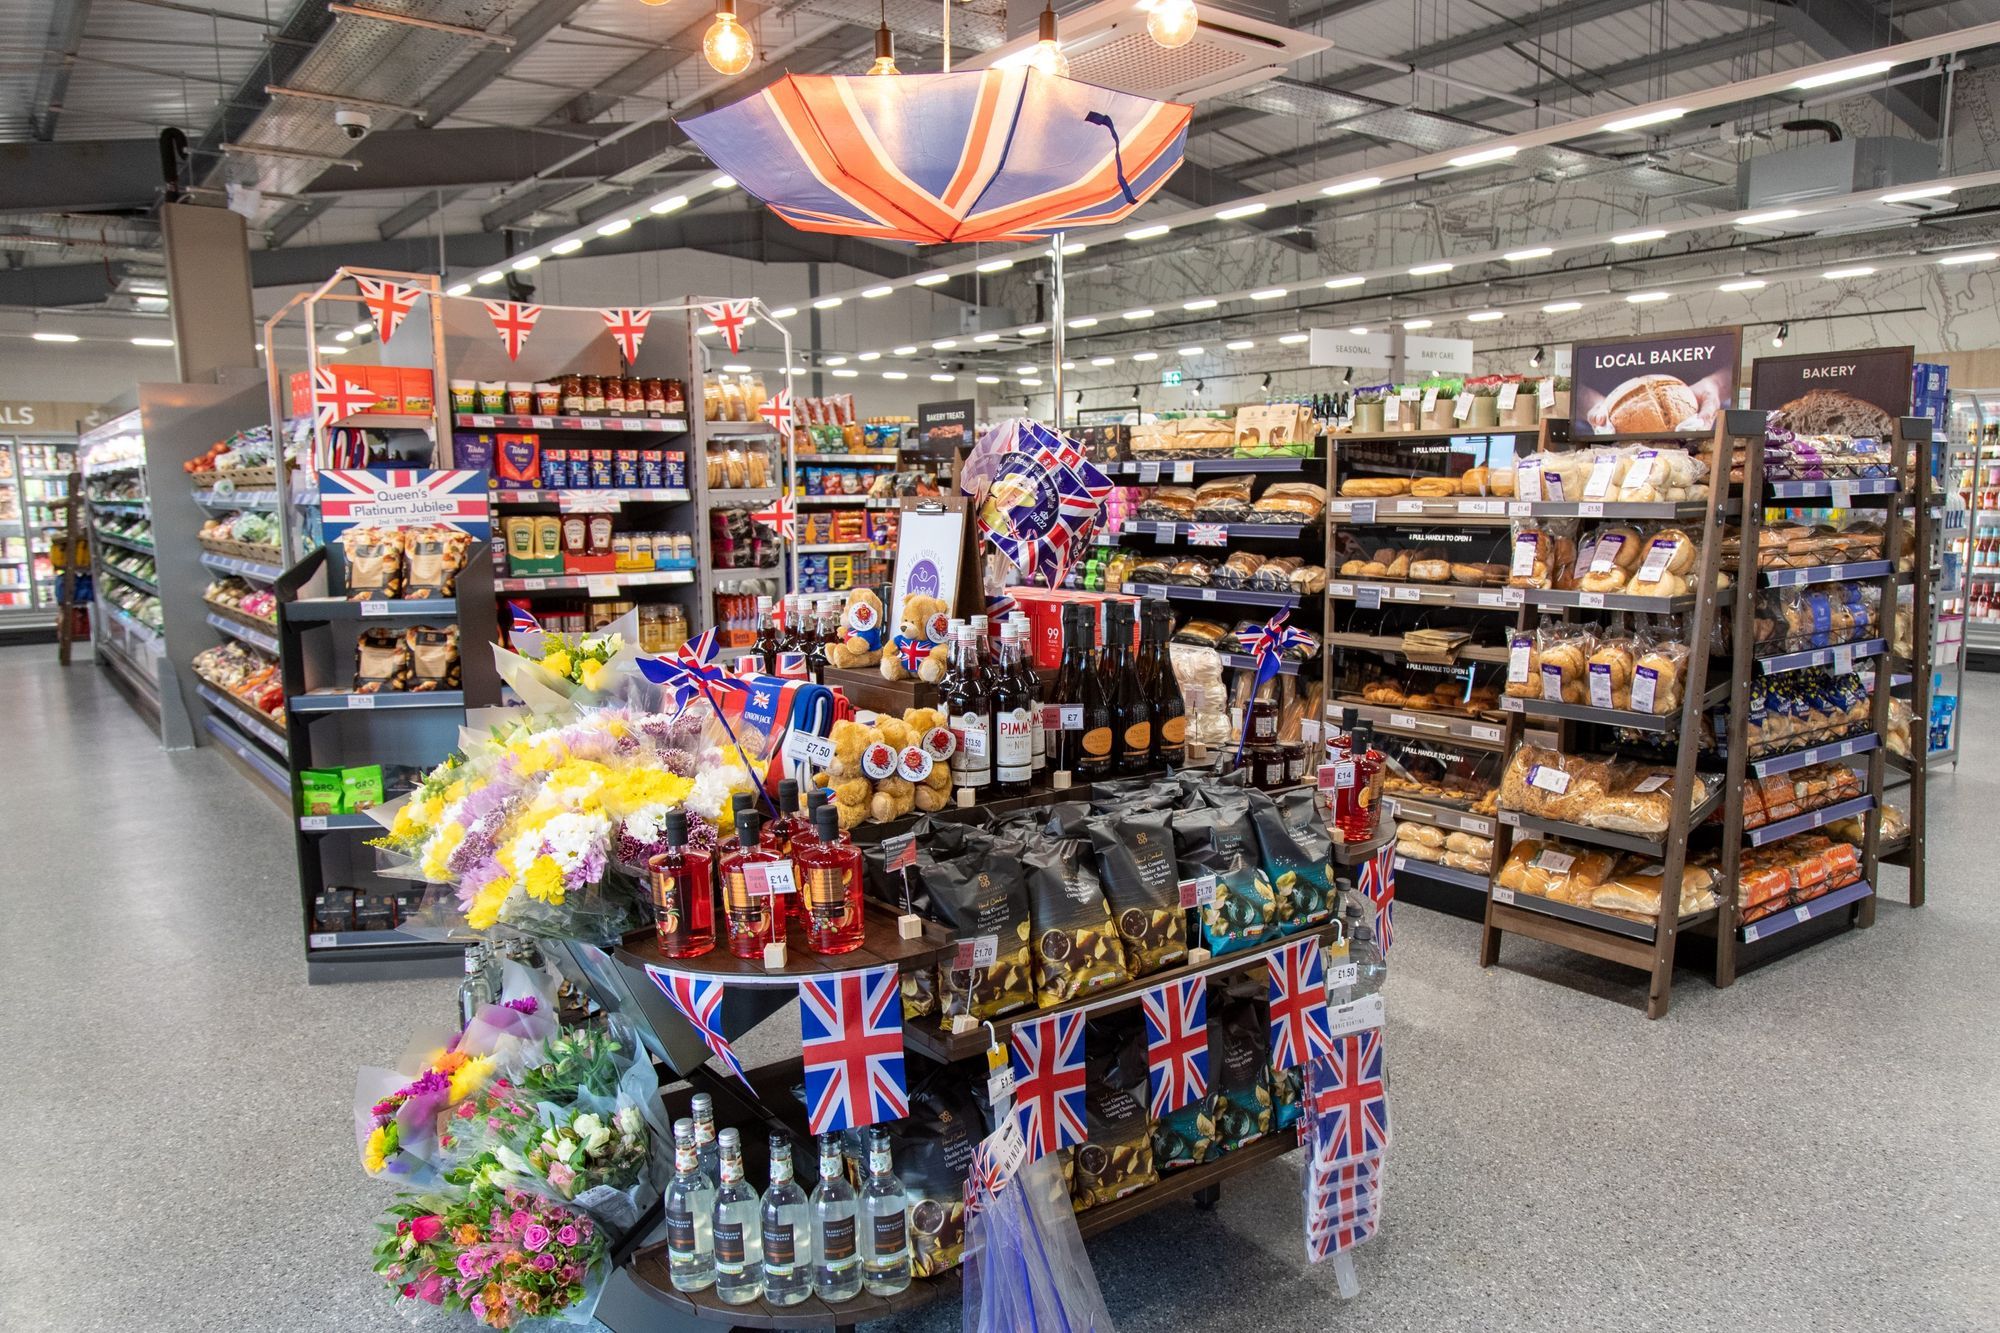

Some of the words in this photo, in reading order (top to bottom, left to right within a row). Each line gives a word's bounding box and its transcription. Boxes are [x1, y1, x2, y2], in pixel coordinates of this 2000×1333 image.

[1335, 344, 1371, 355] SEASONAL
[1421, 350, 1436, 359] BABY
[1439, 352, 1454, 360] CARE
[1595, 351, 1645, 369] LOCAL
[1650, 345, 1715, 365] BAKERY
[1802, 365, 1857, 379] BAKERY
[0, 407, 35, 425] LS
[926, 412, 946, 422] BAKERY
[947, 411, 965, 420] TREATS
[377, 489, 429, 502] Queen's
[354, 503, 407, 517] Platinum
[410, 501, 454, 513] Jubilee
[421, 515, 436, 523] 2022
[1030, 511, 1047, 530] 2022
[1408, 589, 1419, 598] 50p
[1512, 591, 1523, 599] 80p
[1047, 628, 1059, 640] 99
[1422, 665, 1442, 673] HANDLE
[744, 711, 760, 722] UNION
[759, 714, 771, 724] JACK
[1067, 713, 1078, 721] £7
[1406, 717, 1414, 725] £1
[1488, 730, 1497, 738] £1
[965, 737, 982, 748] £13.50
[806, 742, 831, 758] £7.50
[1405, 746, 1417, 755] PULL
[1417, 749, 1438, 758] HANDLE
[1446, 754, 1460, 762] OPEN
[1337, 771, 1351, 780] £14
[313, 783, 334, 791] GRO
[355, 779, 375, 789] GRO
[1148, 859, 1166, 867] Country
[770, 875, 789, 884] £14
[1197, 886, 1213, 896] £1.70
[991, 915, 1010, 924] Chutney
[974, 947, 993, 958] £1.70
[1338, 967, 1355, 979] £1.50
[1331, 1022, 1345, 1030] FABRIC
[1346, 1018, 1365, 1028] BUNTING
[1001, 1071, 1015, 1089] £1.5
[1111, 1094, 1128, 1103] Country
